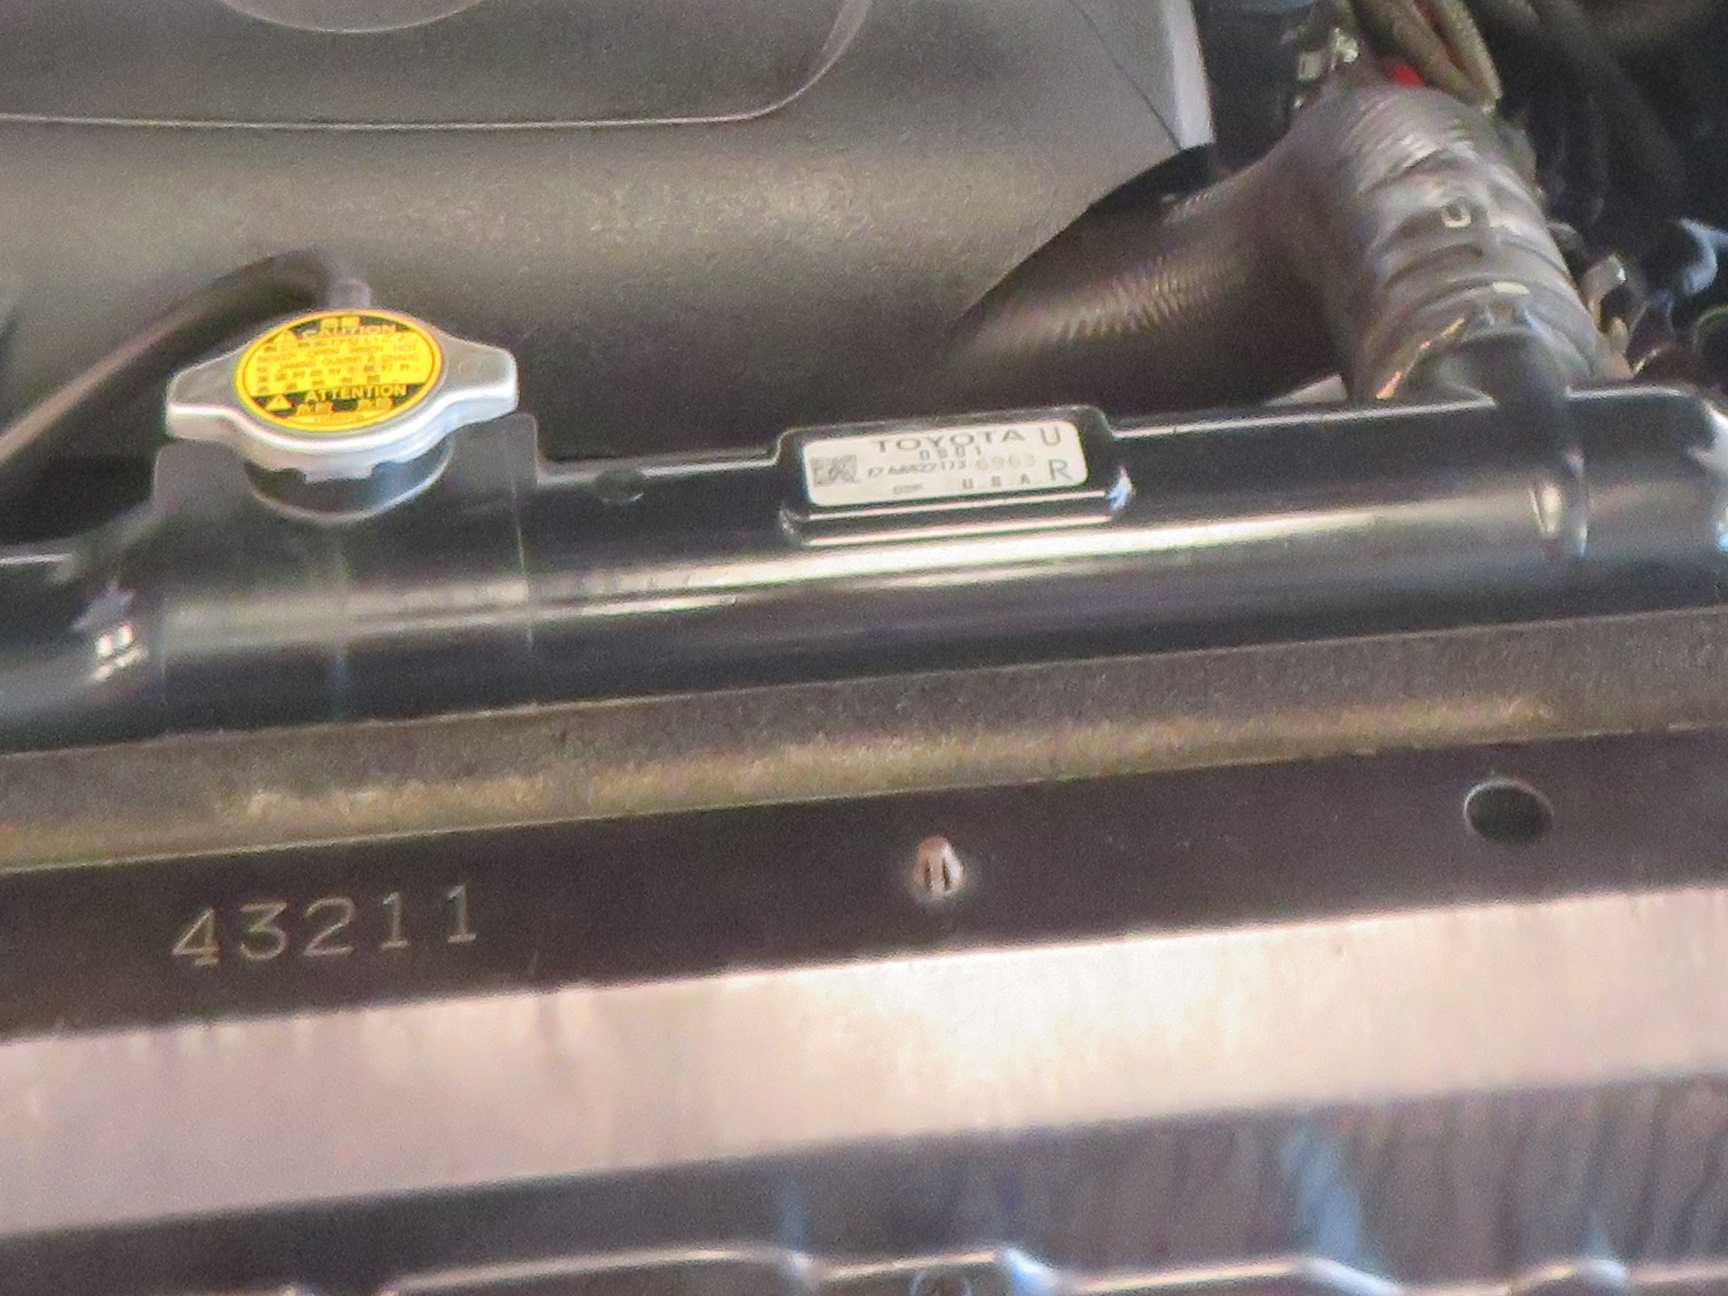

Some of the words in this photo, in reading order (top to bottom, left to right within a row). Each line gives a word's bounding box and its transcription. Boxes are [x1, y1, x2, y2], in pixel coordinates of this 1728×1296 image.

[305, 384, 408, 402] ATTENTION
[874, 428, 1025, 454] TOYOTA
[1039, 426, 1062, 447] U
[1047, 458, 1071, 481] R
[173, 884, 477, 967] 43211
